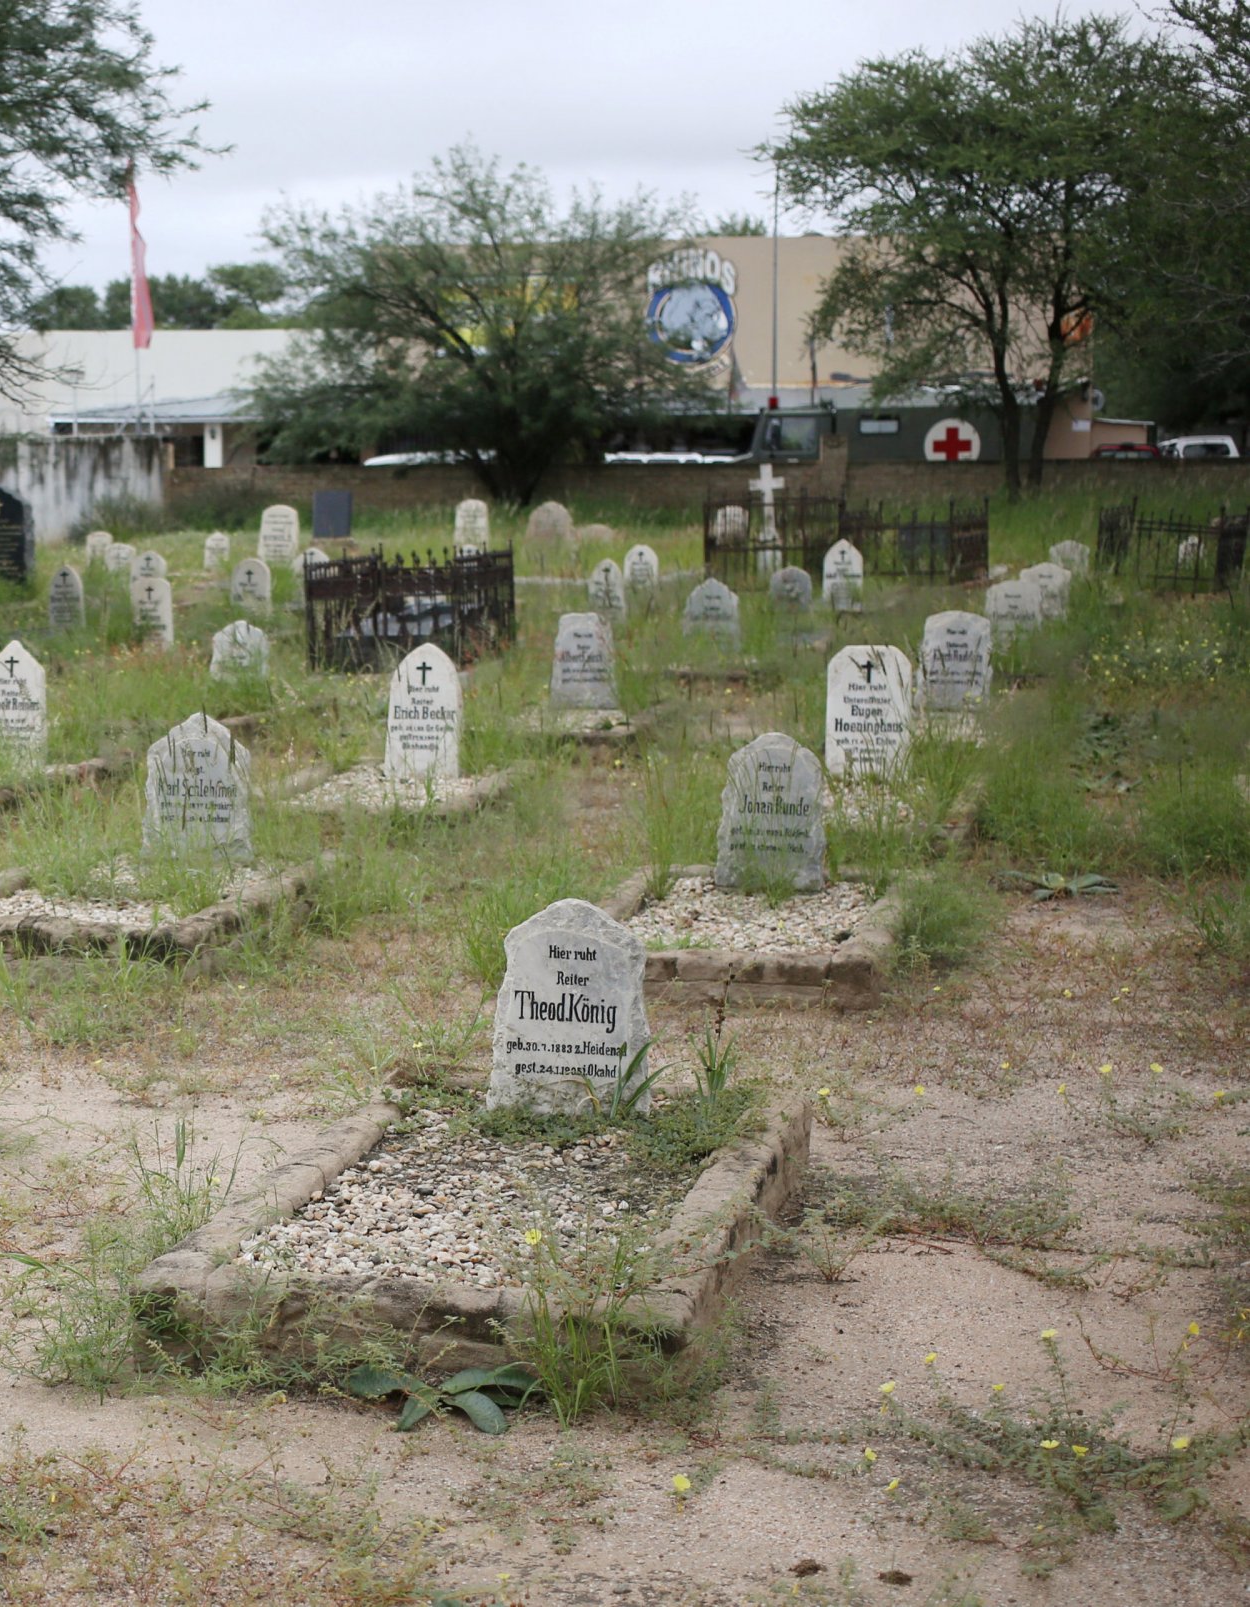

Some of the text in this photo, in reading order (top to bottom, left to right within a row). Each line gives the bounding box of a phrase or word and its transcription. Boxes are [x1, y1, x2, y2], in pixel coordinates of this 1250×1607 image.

[394, 705, 420, 720] Erich
[851, 705, 883, 719] Eugen
[775, 796, 810, 817] Runde
[549, 945, 597, 962] Hier ruht
[556, 971, 590, 987] Reiter
